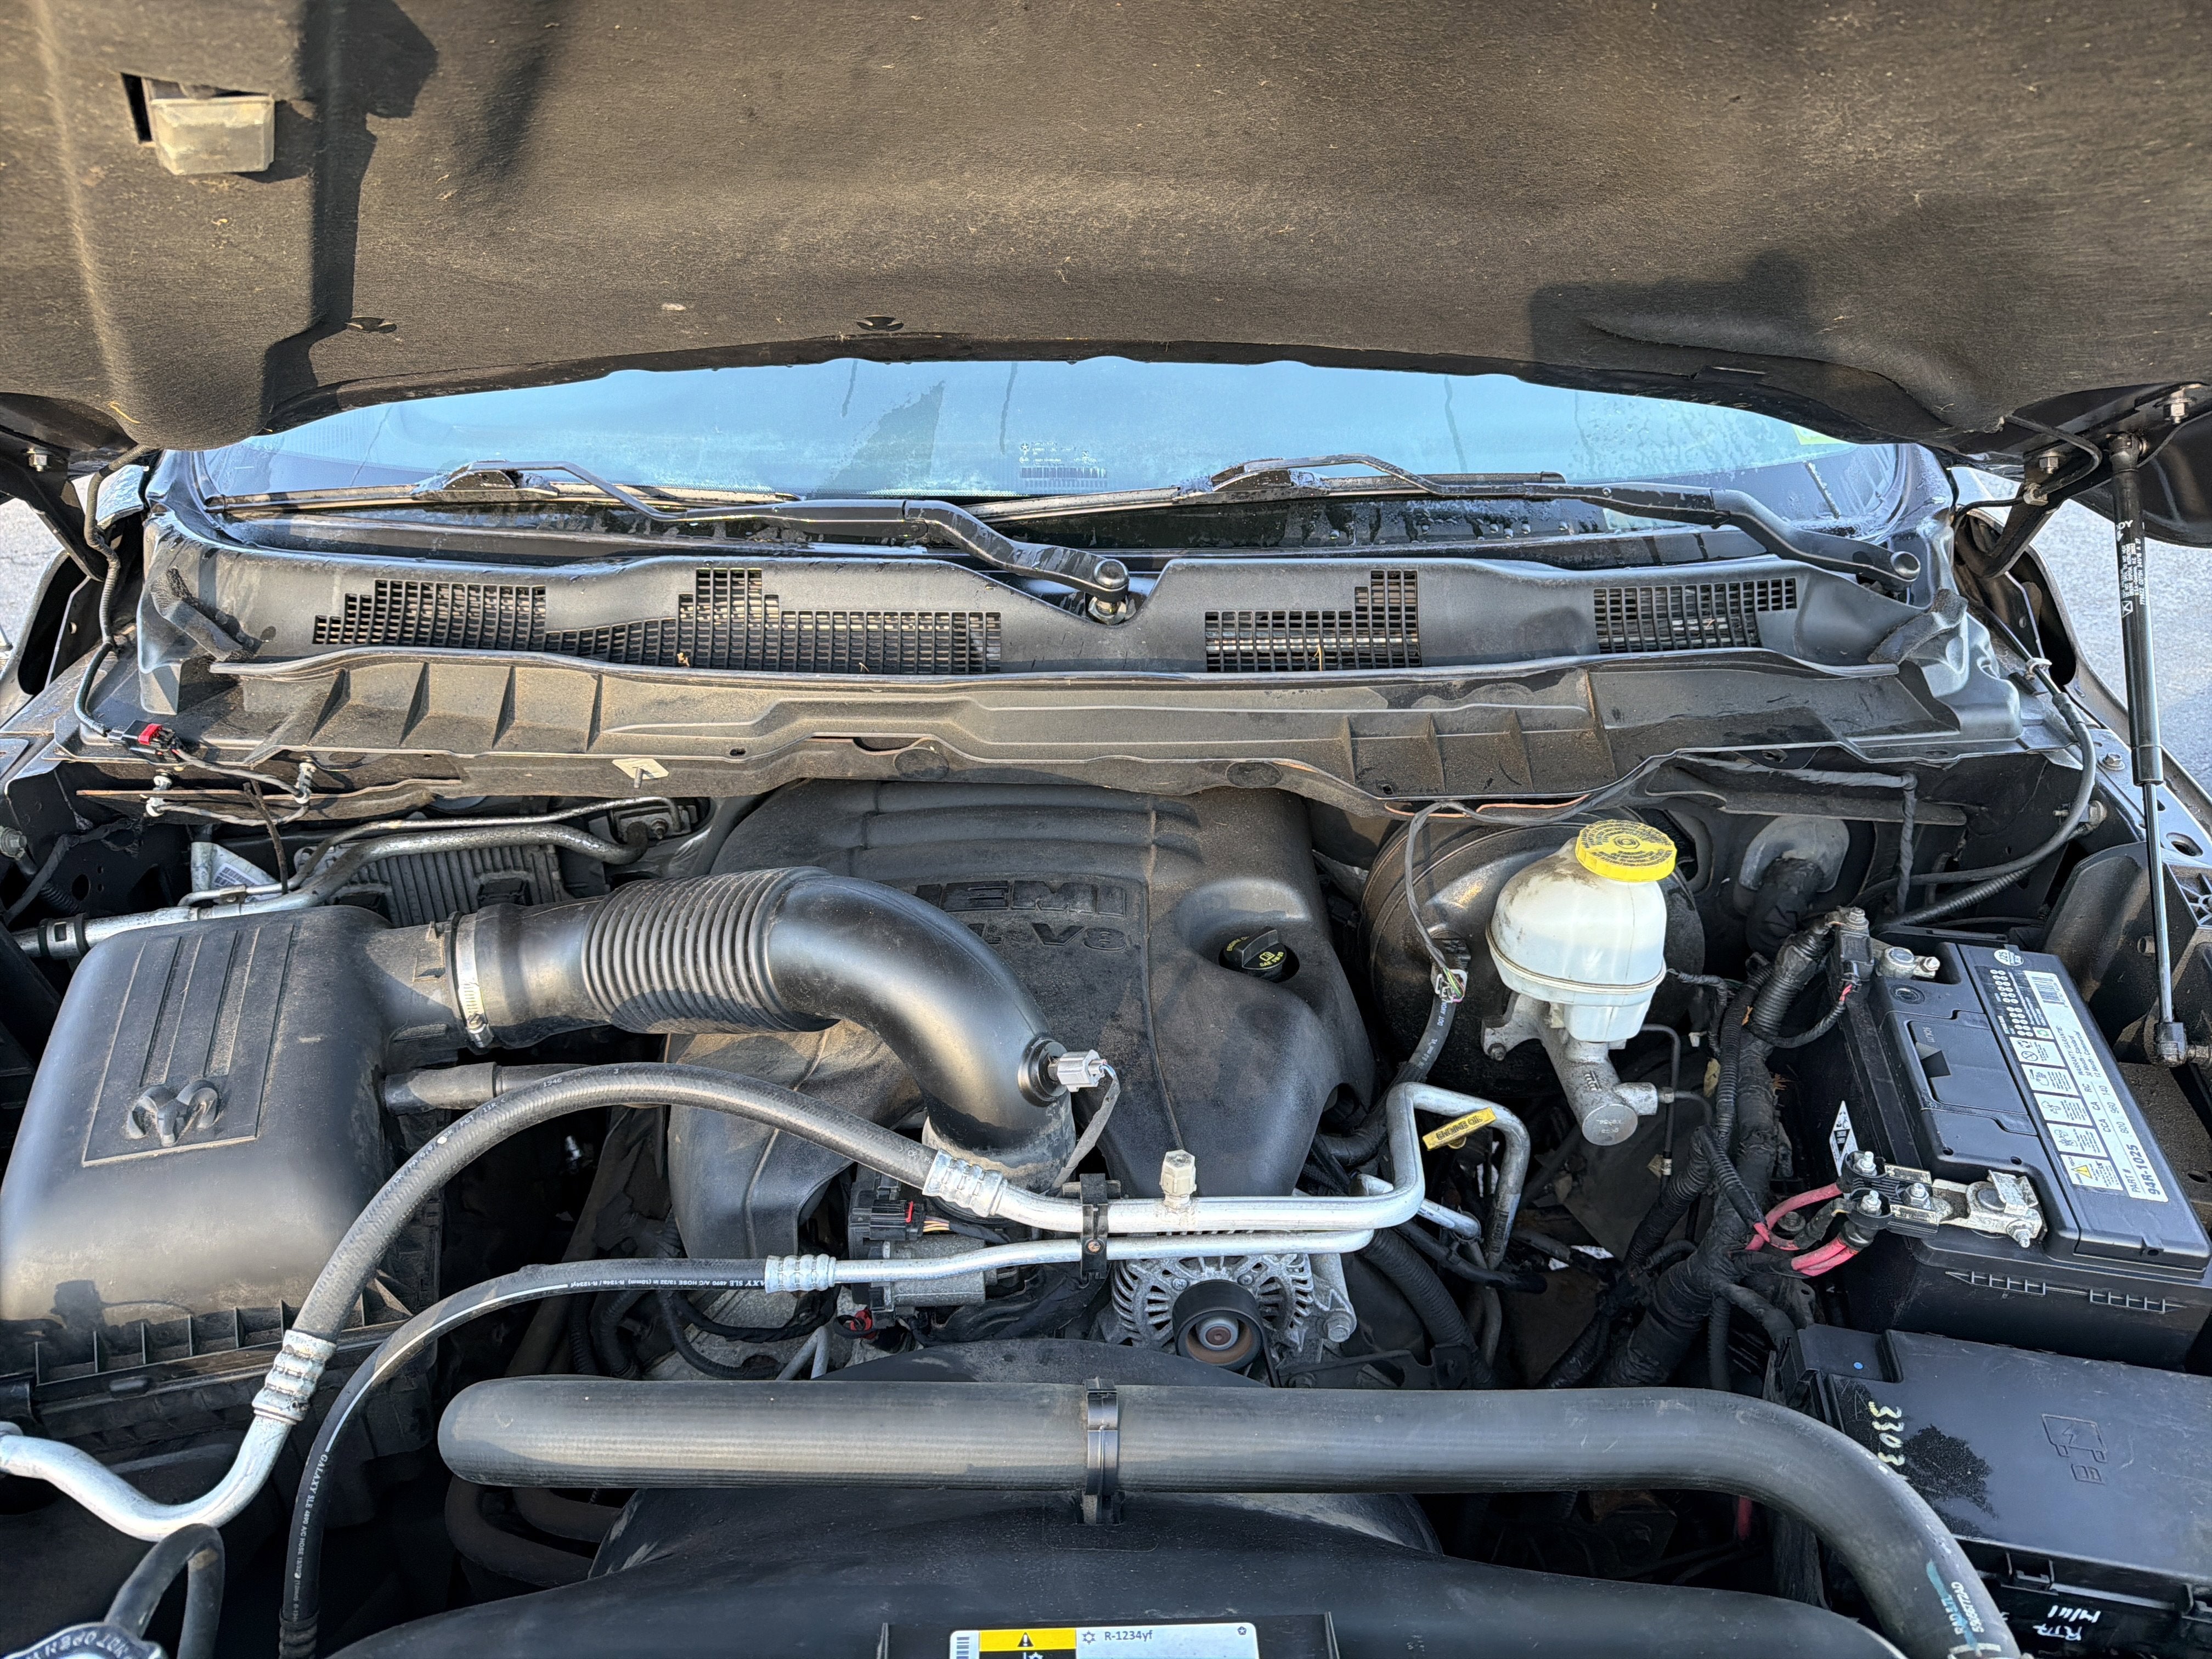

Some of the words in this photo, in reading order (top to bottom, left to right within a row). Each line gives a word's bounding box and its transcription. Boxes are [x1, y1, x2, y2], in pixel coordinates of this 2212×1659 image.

[1030, 923, 1127, 951] V8
[1226, 938, 1241, 951] ENGINE
[542, 1077, 563, 1088] 1946
[2082, 1084, 2092, 1092] RC
[2098, 1085, 2111, 1096] 140
[2090, 1102, 2101, 1110] CA
[2107, 1102, 2119, 1114] 960
[459, 1114, 475, 1127] PET
[2098, 1119, 2111, 1132] CCA
[1436, 1120, 1469, 1140] ENGINE
[1467, 1115, 1483, 1126] OIL
[2128, 1144, 2160, 1195] 94R-1025
[2126, 1175, 2141, 1193] PART
[570, 1279, 598, 1288] R-1234yf
[309, 1454, 328, 1494] GALAXY
[304, 1494, 315, 1509] SLE
[297, 1538, 306, 1556] HOSE
[1104, 1629, 1153, 1642] R-1234yf
